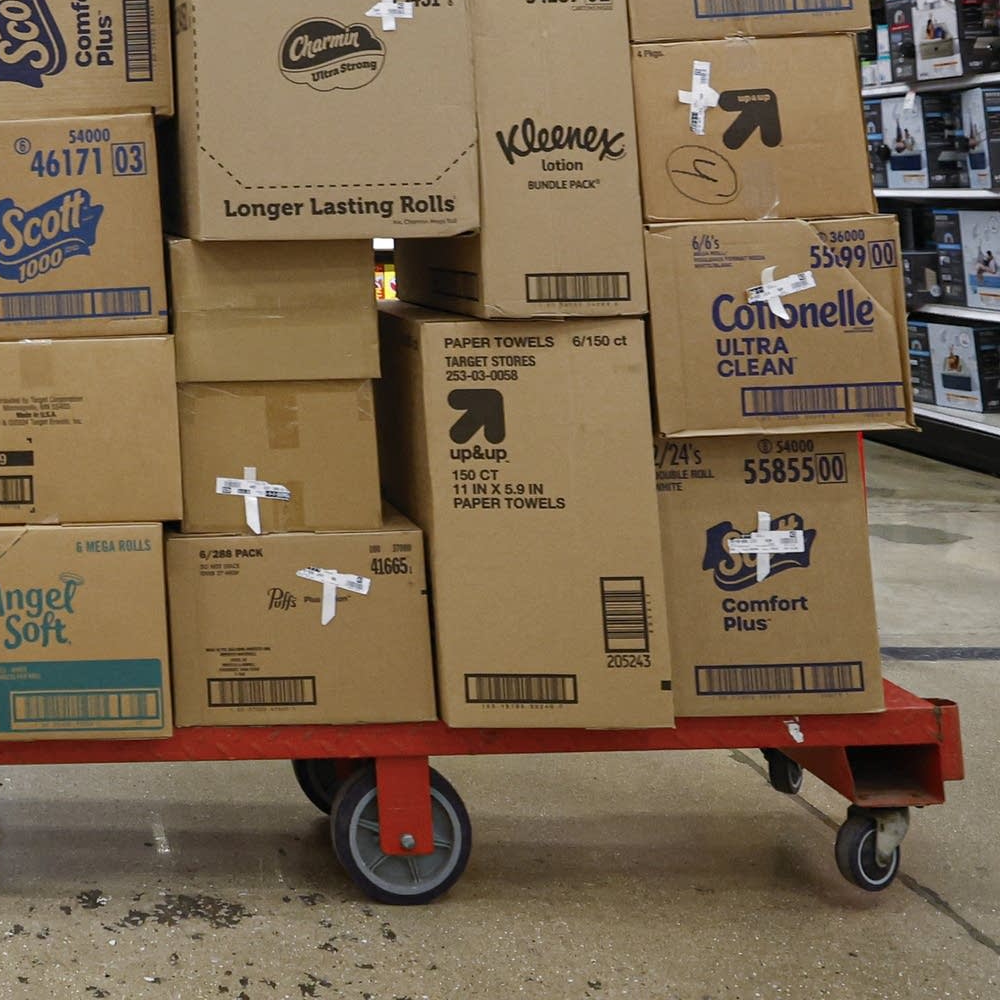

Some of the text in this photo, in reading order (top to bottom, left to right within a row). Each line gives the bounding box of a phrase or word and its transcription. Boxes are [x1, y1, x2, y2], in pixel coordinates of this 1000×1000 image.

[97, 15, 114, 66] Plus
[288, 28, 360, 62] Charmin
[311, 59, 377, 82] Ultra Strong
[69, 129, 110, 144] 54000
[496, 117, 625, 165] Kleenex
[31, 148, 101, 177] 46171
[115, 145, 143, 173] 03
[541, 159, 583, 172] lotion
[528, 179, 567, 190] BUNDLE
[224, 195, 455, 220] Longer Lasting Rolls
[830, 229, 865, 243] 36000
[692, 234, 720, 252] 6/6's
[872, 243, 893, 265] 00
[19, 249, 63, 283] 1000
[444, 336, 627, 348] PAPER TOWELS 6/150 ct
[716, 337, 789, 356] ULTRA
[445, 356, 536, 368] TARGET STORES
[717, 358, 795, 377] CLEAN
[446, 370, 518, 381] 253-03-0058
[450, 445, 507, 463] up&up
[776, 440, 814, 453] 54000
[452, 470, 499, 481] 150 CT
[690, 469, 715, 478] ROLL
[744, 457, 814, 484] 55855
[819, 456, 843, 481] 00
[453, 484, 543, 495] 11 IN X 5.9 IN
[453, 497, 566, 509] PAPER TOWELS
[76, 539, 151, 553] 6 MEGA ROLLS
[199, 548, 264, 560] 6/288 PACK
[371, 557, 408, 575] 41665
[267, 587, 297, 611] Puffs
[722, 596, 808, 613] Comfort
[4, 612, 69, 650] Soft
[724, 617, 768, 631] Plus
[607, 654, 651, 668] 205243
